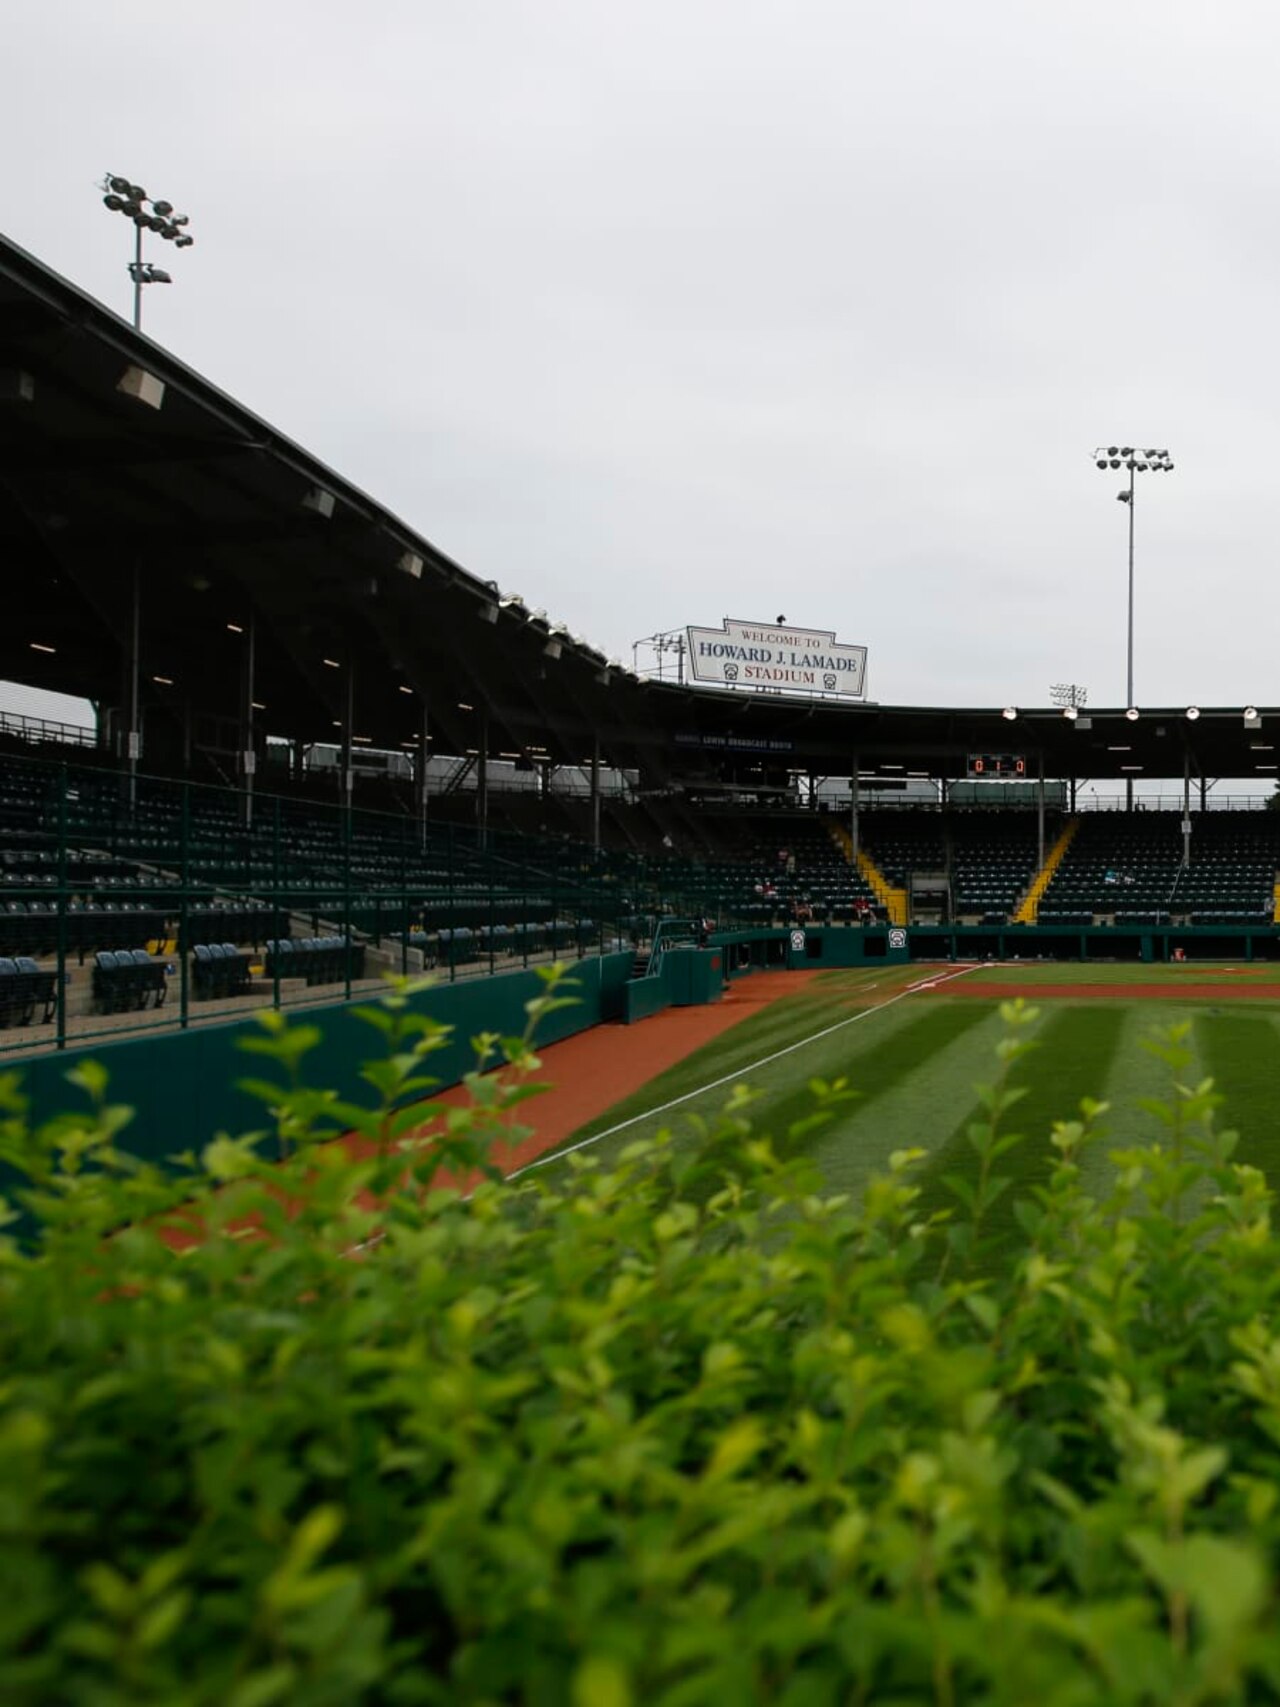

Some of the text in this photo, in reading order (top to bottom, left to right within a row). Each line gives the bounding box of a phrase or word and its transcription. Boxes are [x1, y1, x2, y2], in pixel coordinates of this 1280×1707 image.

[742, 631, 821, 648] WELCOME TO
[699, 642, 857, 672] HOWARD J. LAMADE
[745, 666, 815, 684] STADIUM
[975, 760, 984, 773] 0
[996, 761, 1001, 771] 1
